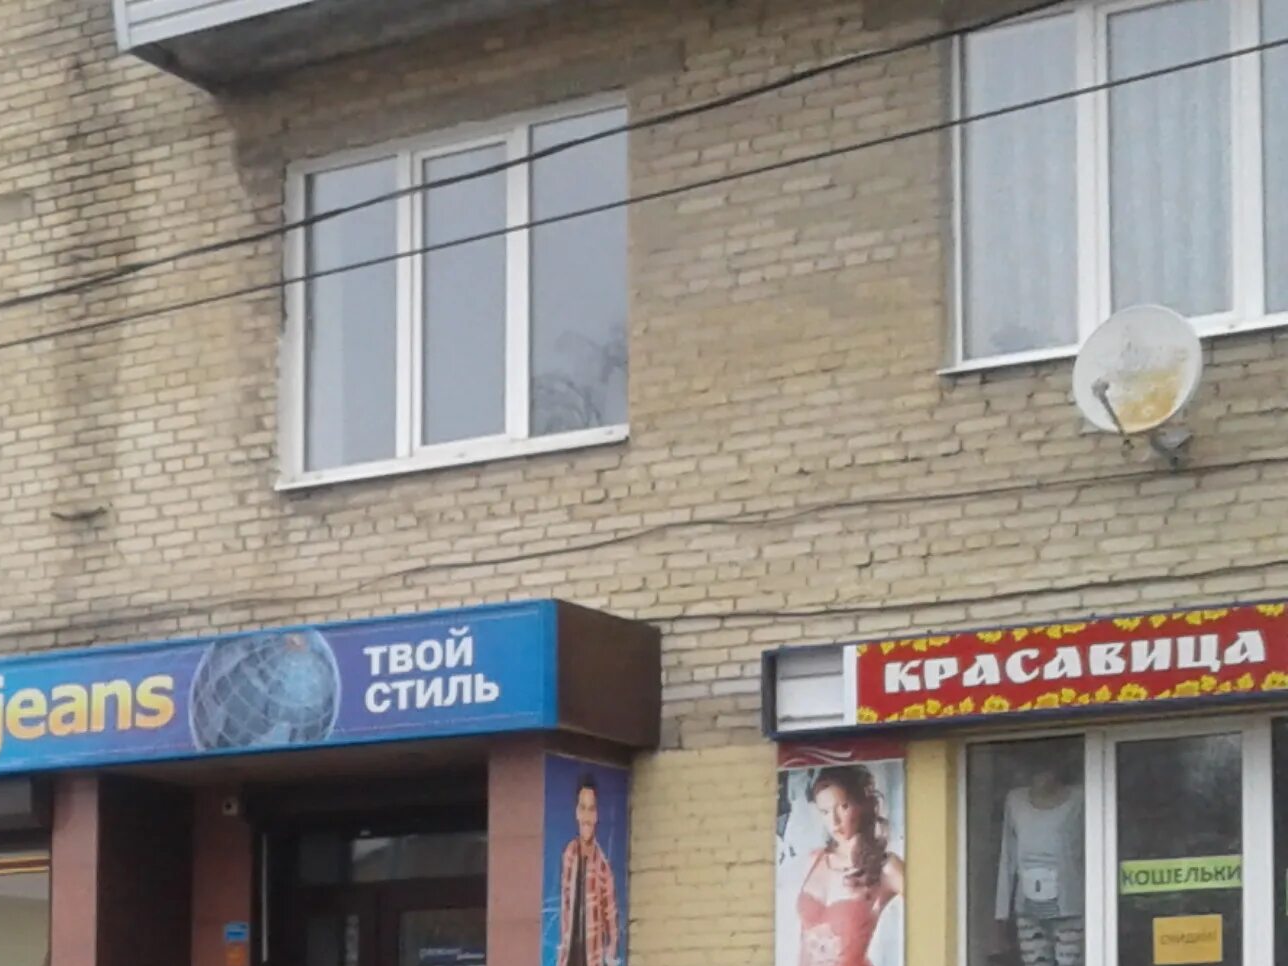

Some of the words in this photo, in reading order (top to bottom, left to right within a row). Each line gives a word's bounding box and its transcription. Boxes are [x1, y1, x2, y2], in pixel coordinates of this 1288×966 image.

[364, 627, 474, 676] ТВОЙ
[884, 630, 1266, 694] КРАСАВИЦА
[365, 674, 500, 713] СТИЛЬ
[1121, 865, 1243, 887] КОШЕЛЬКИ
